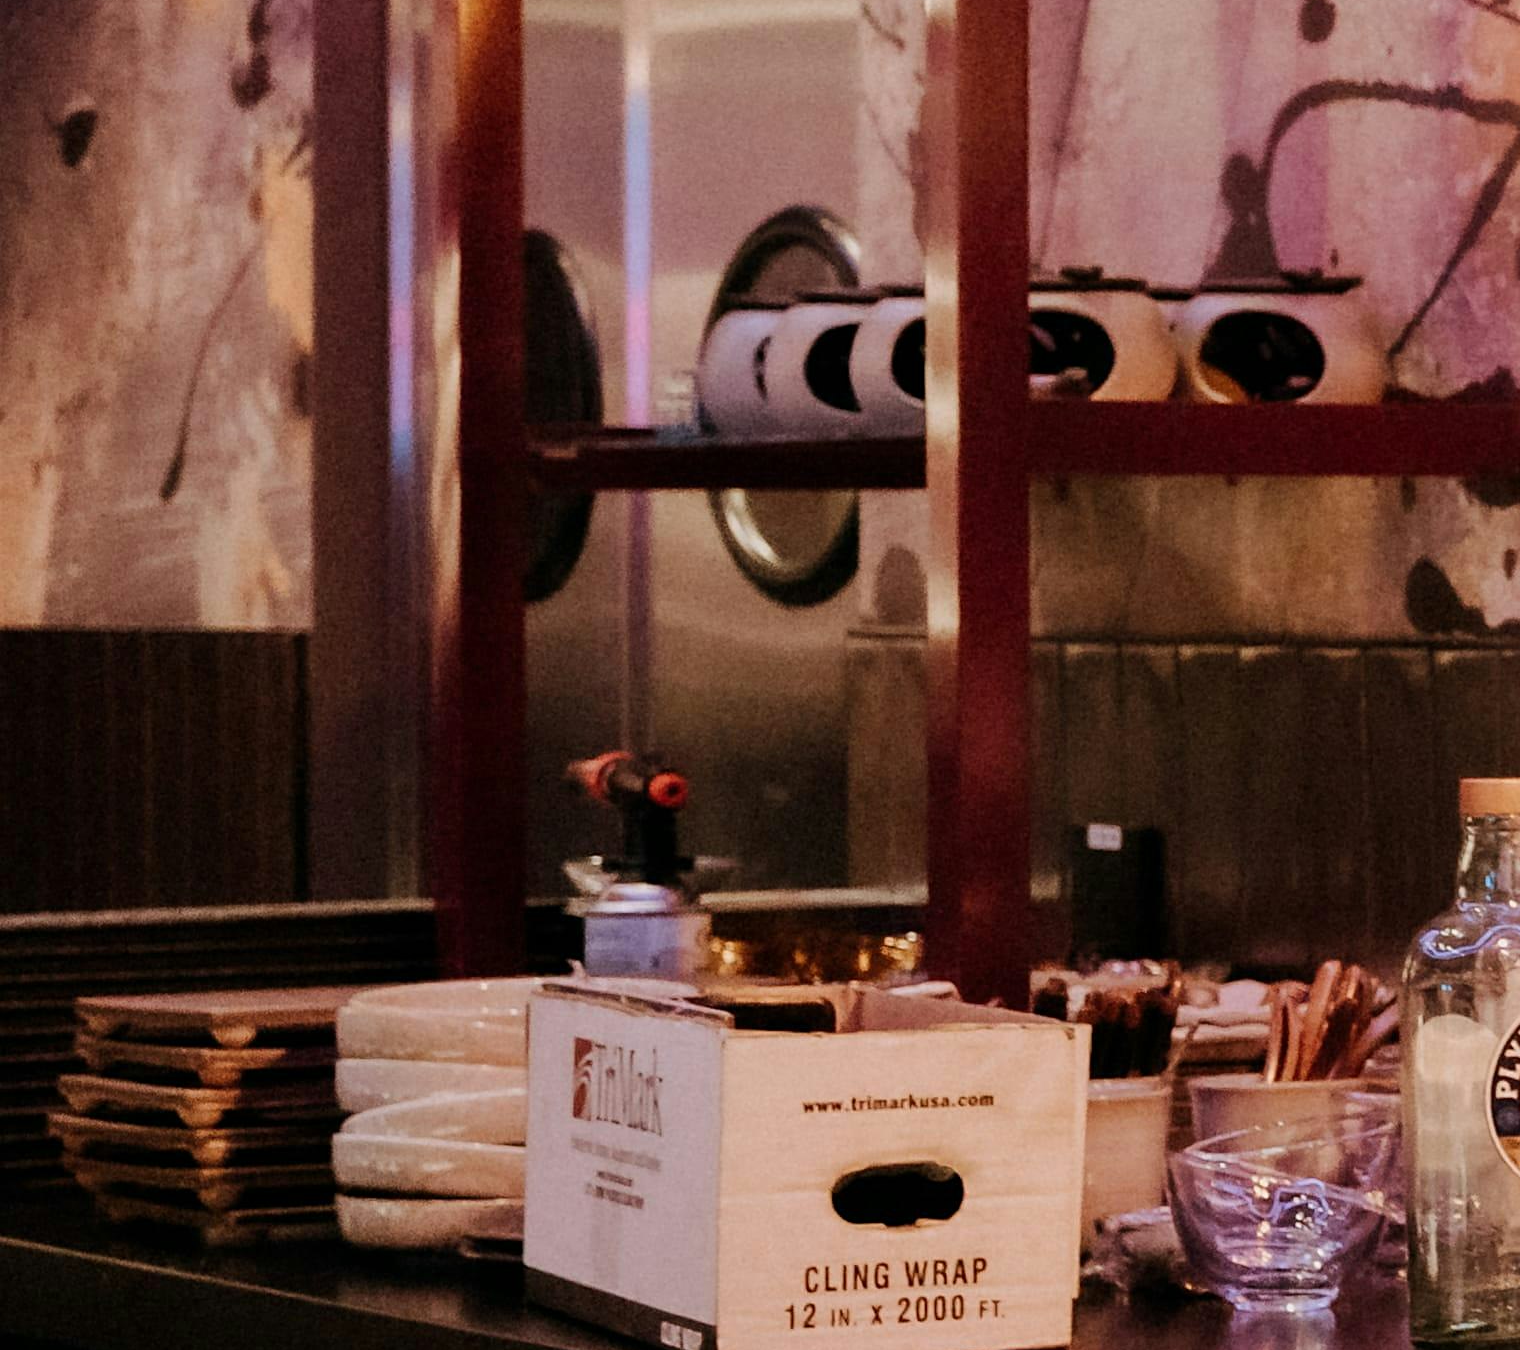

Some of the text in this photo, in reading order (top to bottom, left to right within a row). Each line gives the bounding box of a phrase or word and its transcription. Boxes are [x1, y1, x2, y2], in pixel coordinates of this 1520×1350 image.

[803, 1094, 995, 1114] www.trimarkusa.com
[804, 1257, 988, 1293] CLING WRAP
[785, 1303, 817, 1330] 12
[897, 1294, 966, 1324] 2000
